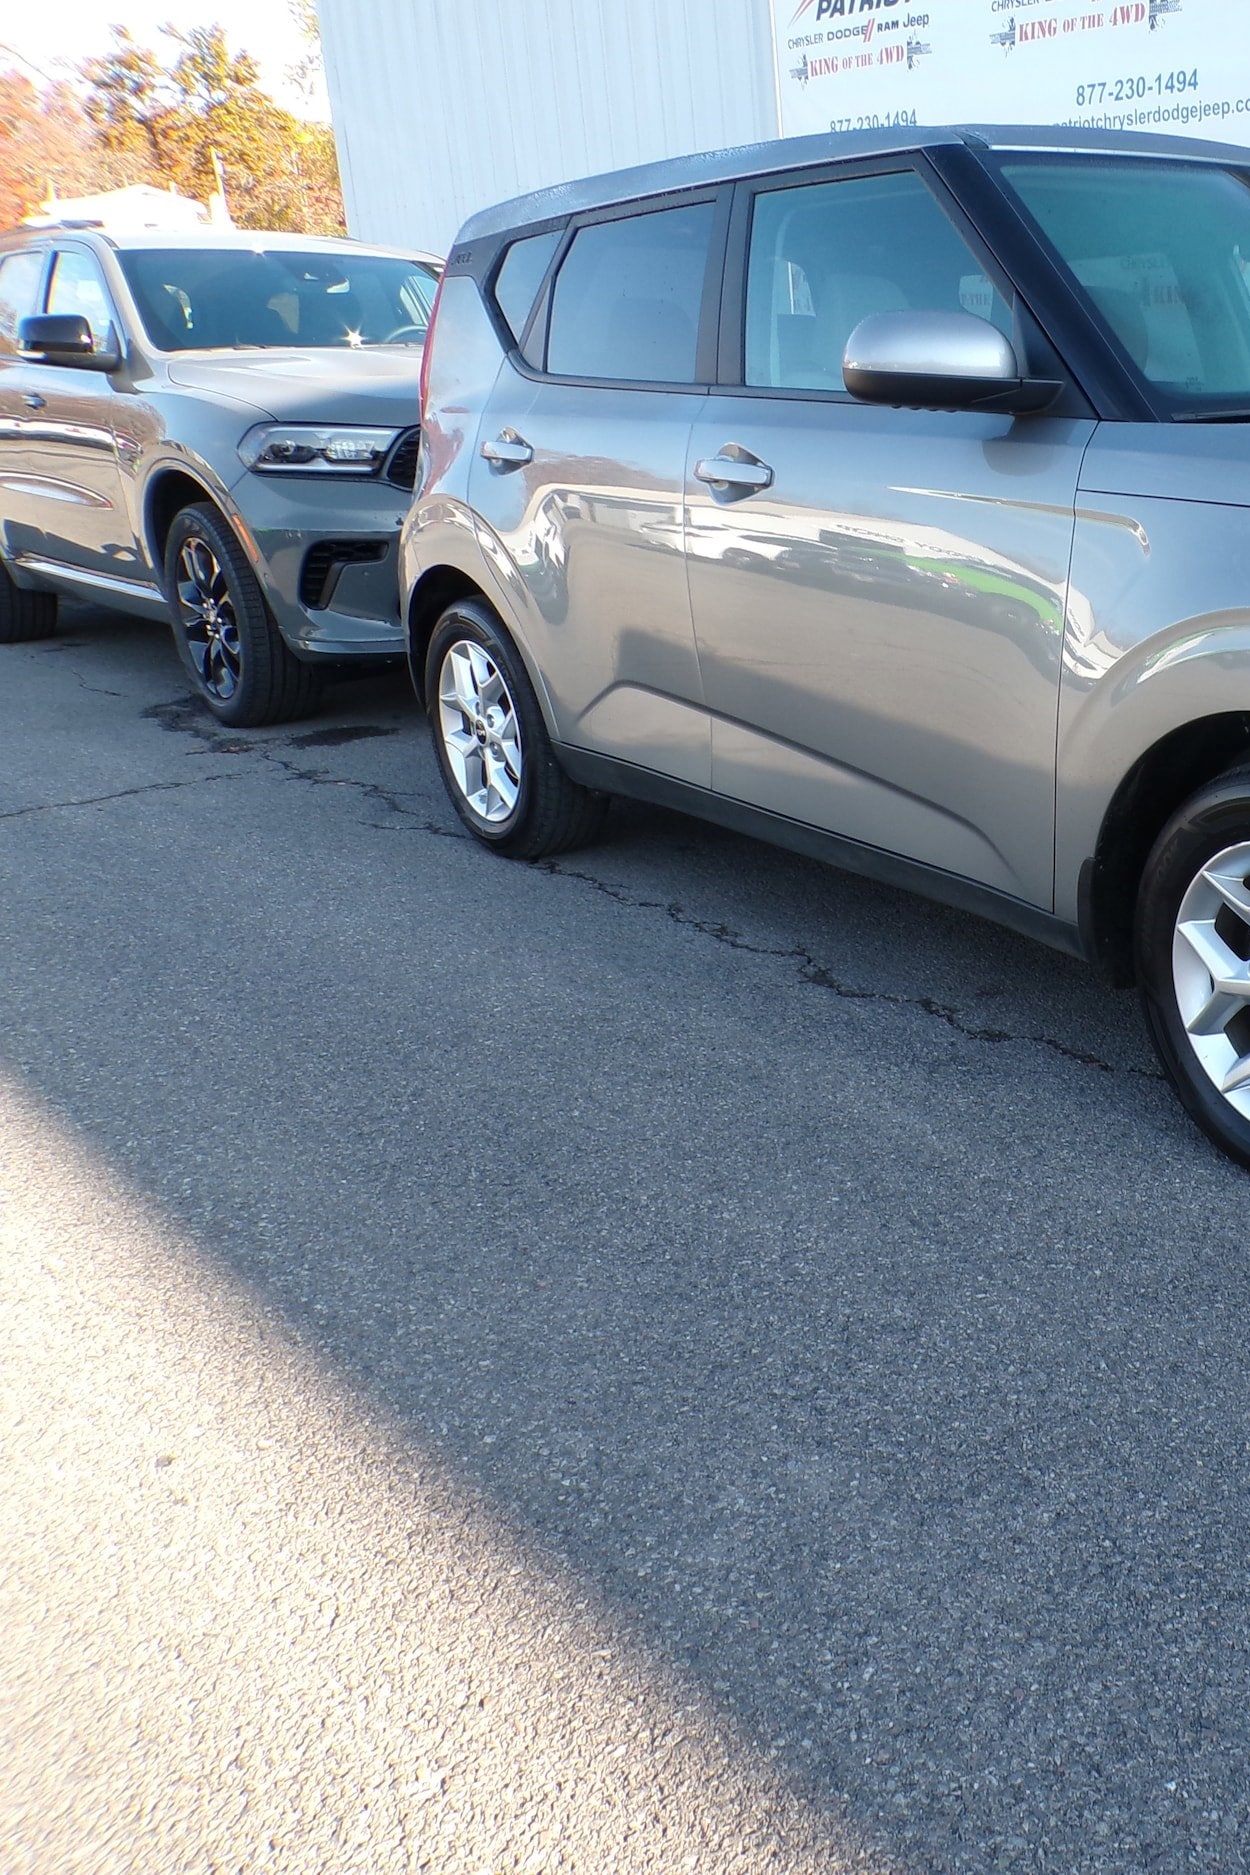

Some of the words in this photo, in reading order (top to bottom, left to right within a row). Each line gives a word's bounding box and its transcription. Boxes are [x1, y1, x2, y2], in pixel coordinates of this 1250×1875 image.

[787, 33, 824, 50] CHRYSLER
[827, 25, 868, 41] DODGE
[877, 20, 899, 33] RAM
[903, 12, 930, 28] Jeep
[1019, 18, 1058, 42] KING
[1063, 18, 1077, 33] OF
[1080, 13, 1104, 30] THE
[1109, 3, 1146, 27] 4WD
[810, 56, 839, 77] KING
[842, 57, 853, 70] OF
[855, 53, 873, 68] THE
[877, 44, 905, 65] 4WD
[1076, 68, 1199, 106] 877-230-1494
